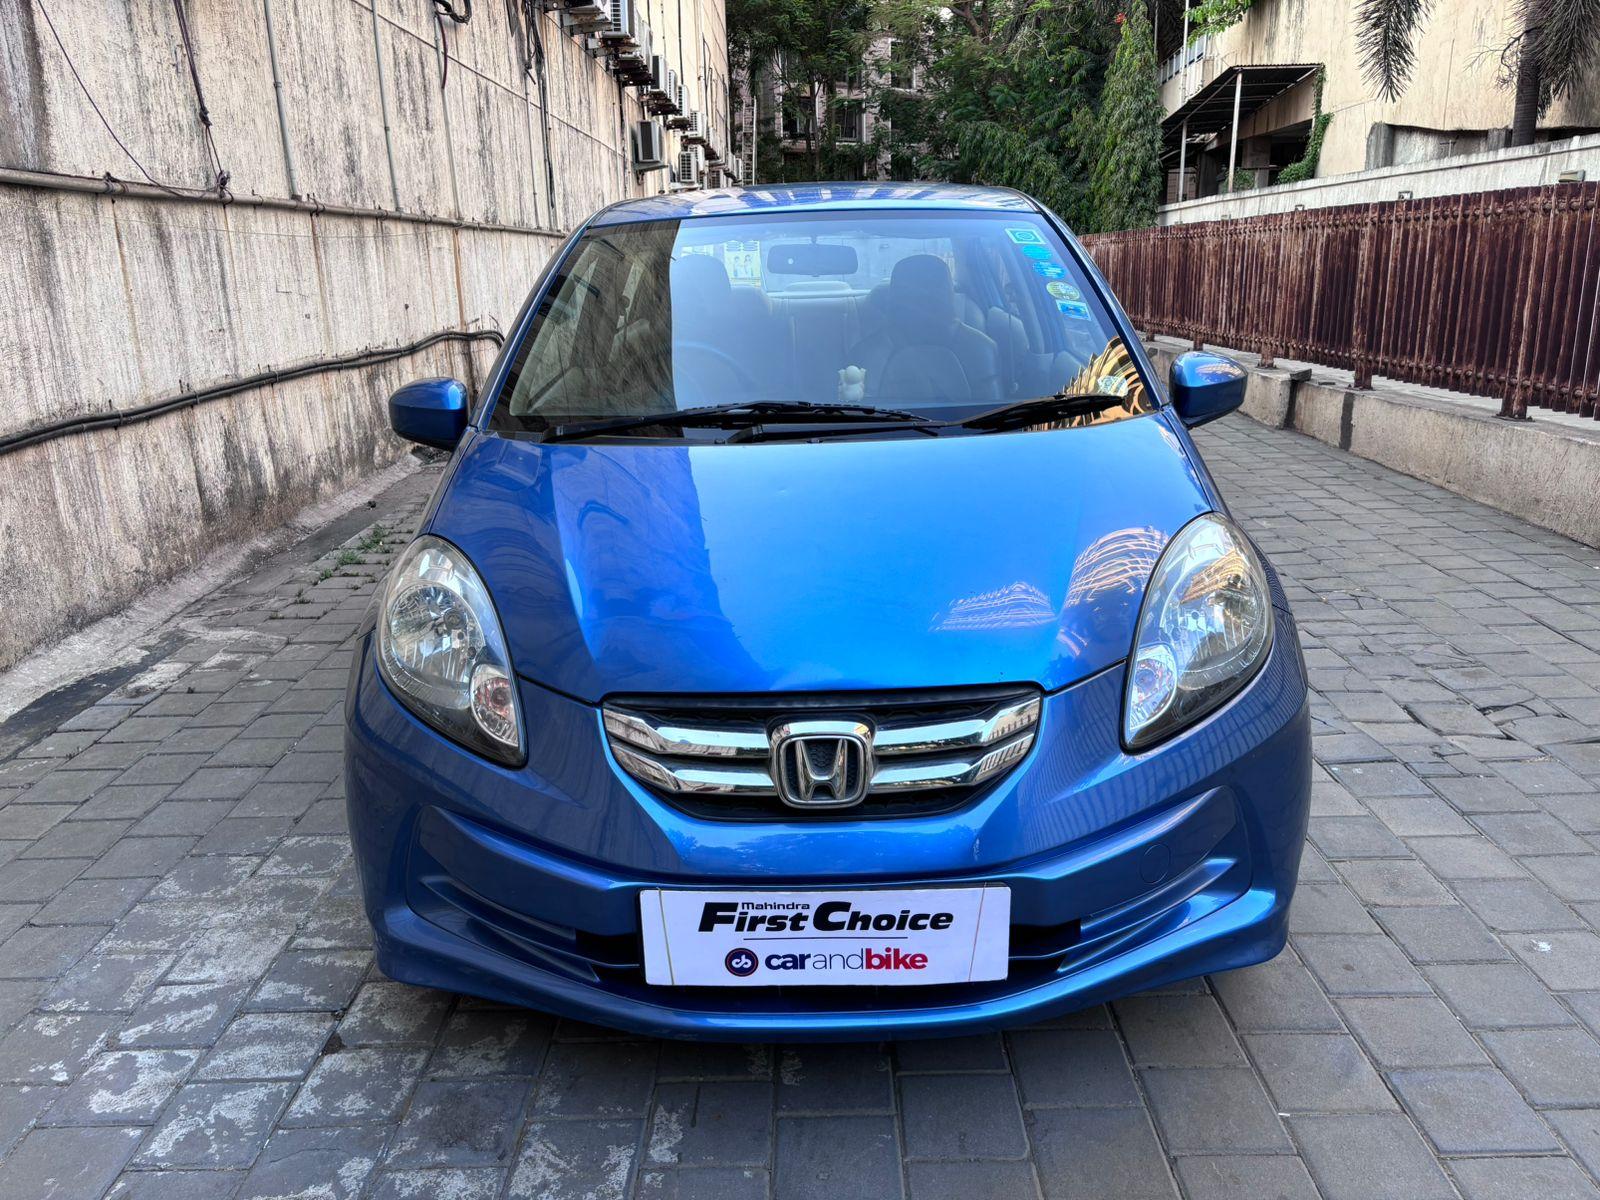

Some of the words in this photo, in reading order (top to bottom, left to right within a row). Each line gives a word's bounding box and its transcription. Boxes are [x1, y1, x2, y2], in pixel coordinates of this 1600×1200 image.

[741, 902, 810, 910] Mahindra
[698, 901, 809, 932] First
[813, 901, 954, 932] Choice
